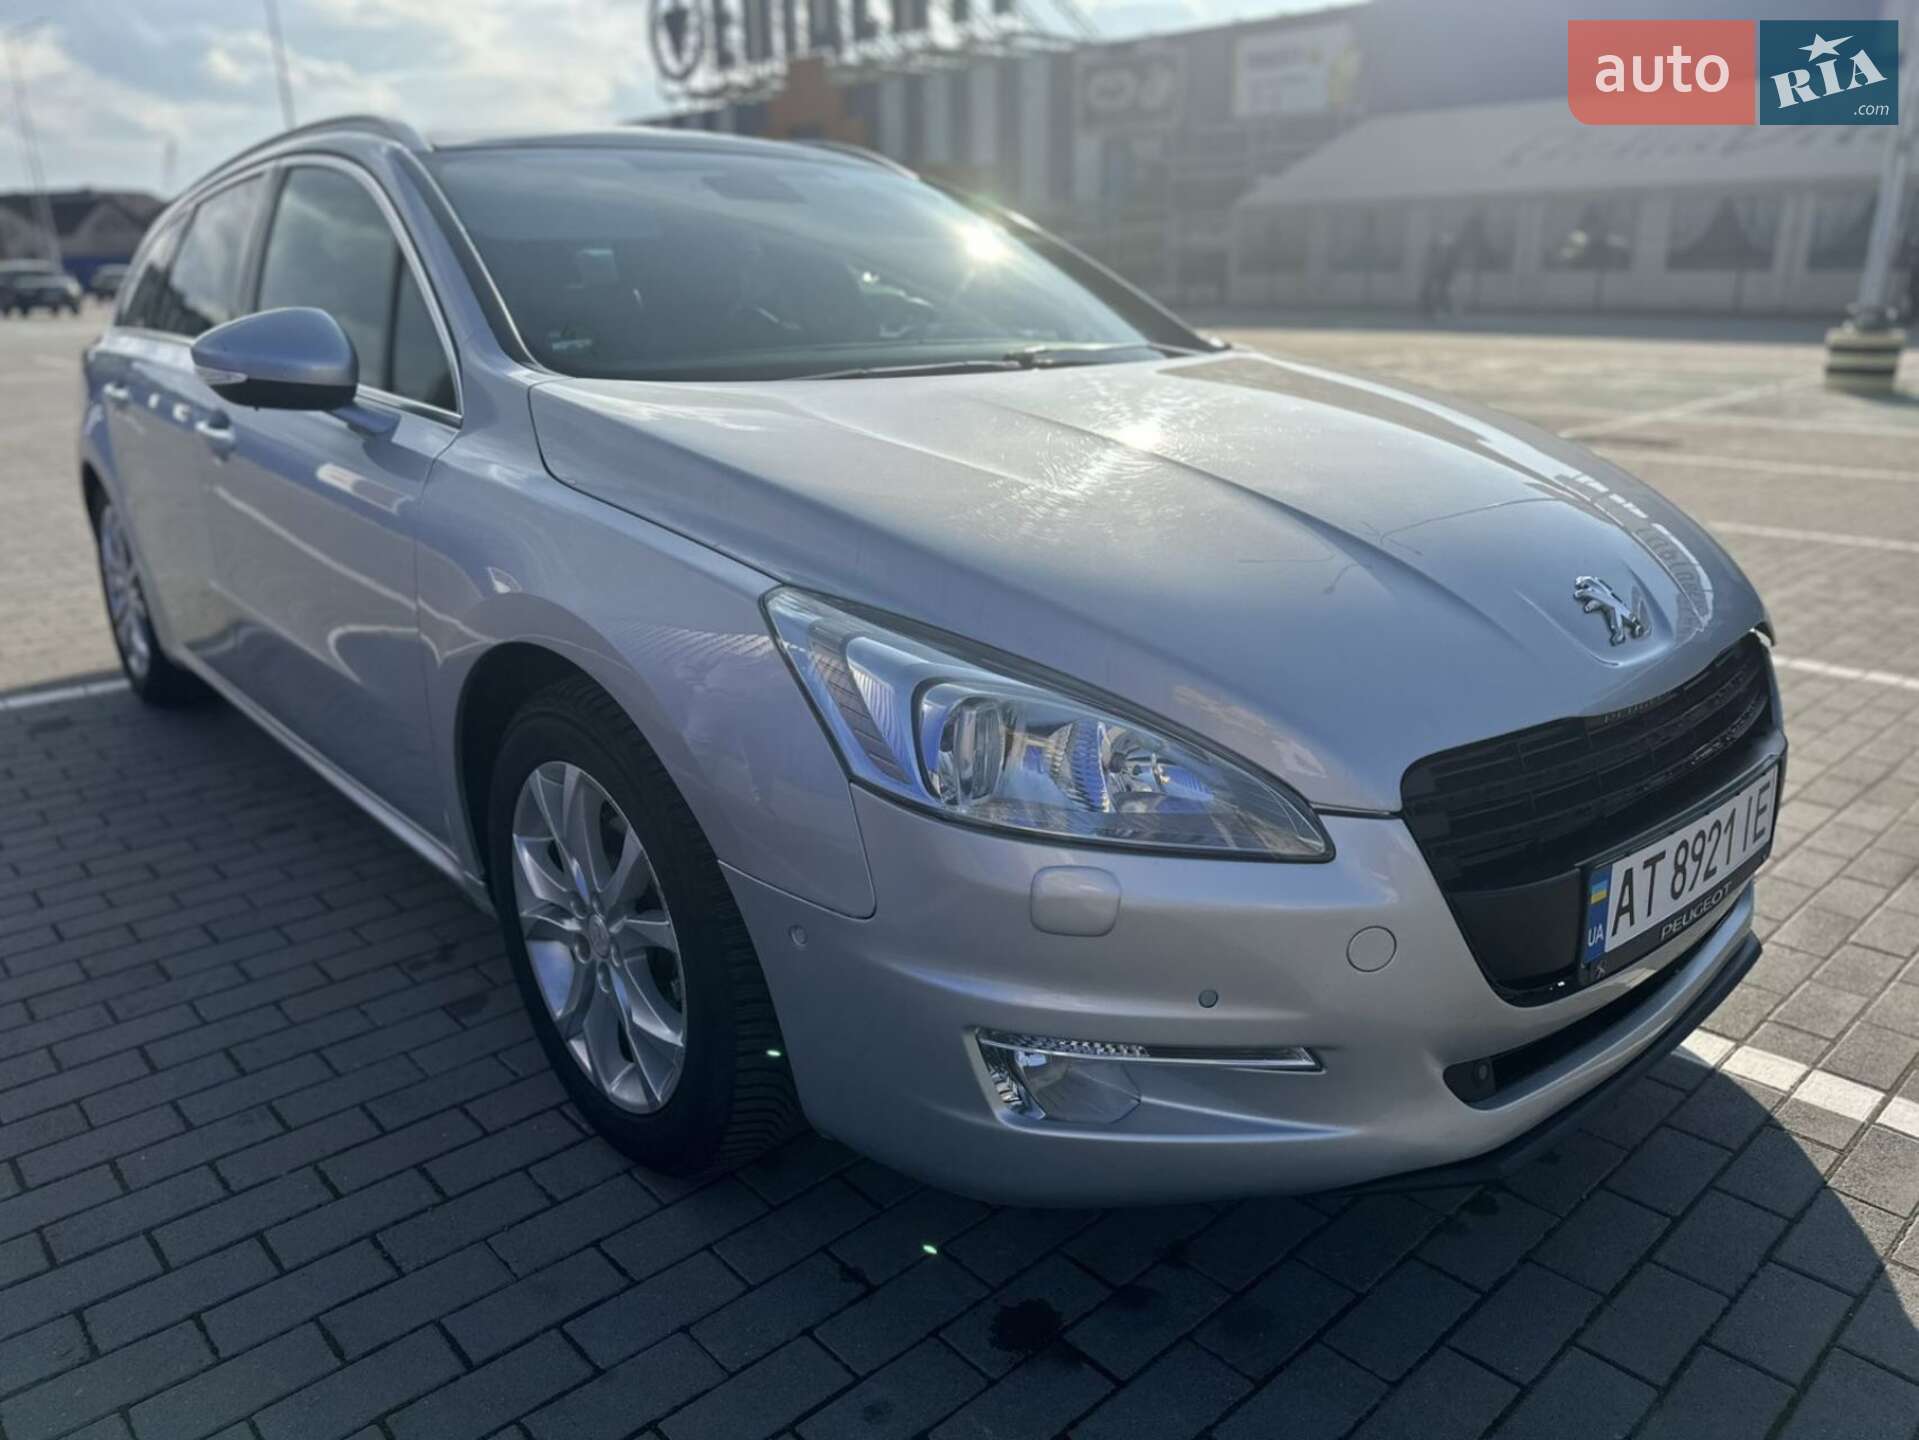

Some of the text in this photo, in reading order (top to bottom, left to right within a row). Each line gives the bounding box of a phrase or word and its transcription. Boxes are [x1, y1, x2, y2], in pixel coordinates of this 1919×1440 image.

[1611, 780, 1771, 937] AT 8921 IE
[1587, 924, 1605, 947] UA
[1661, 880, 1732, 941] PEUGEOT
